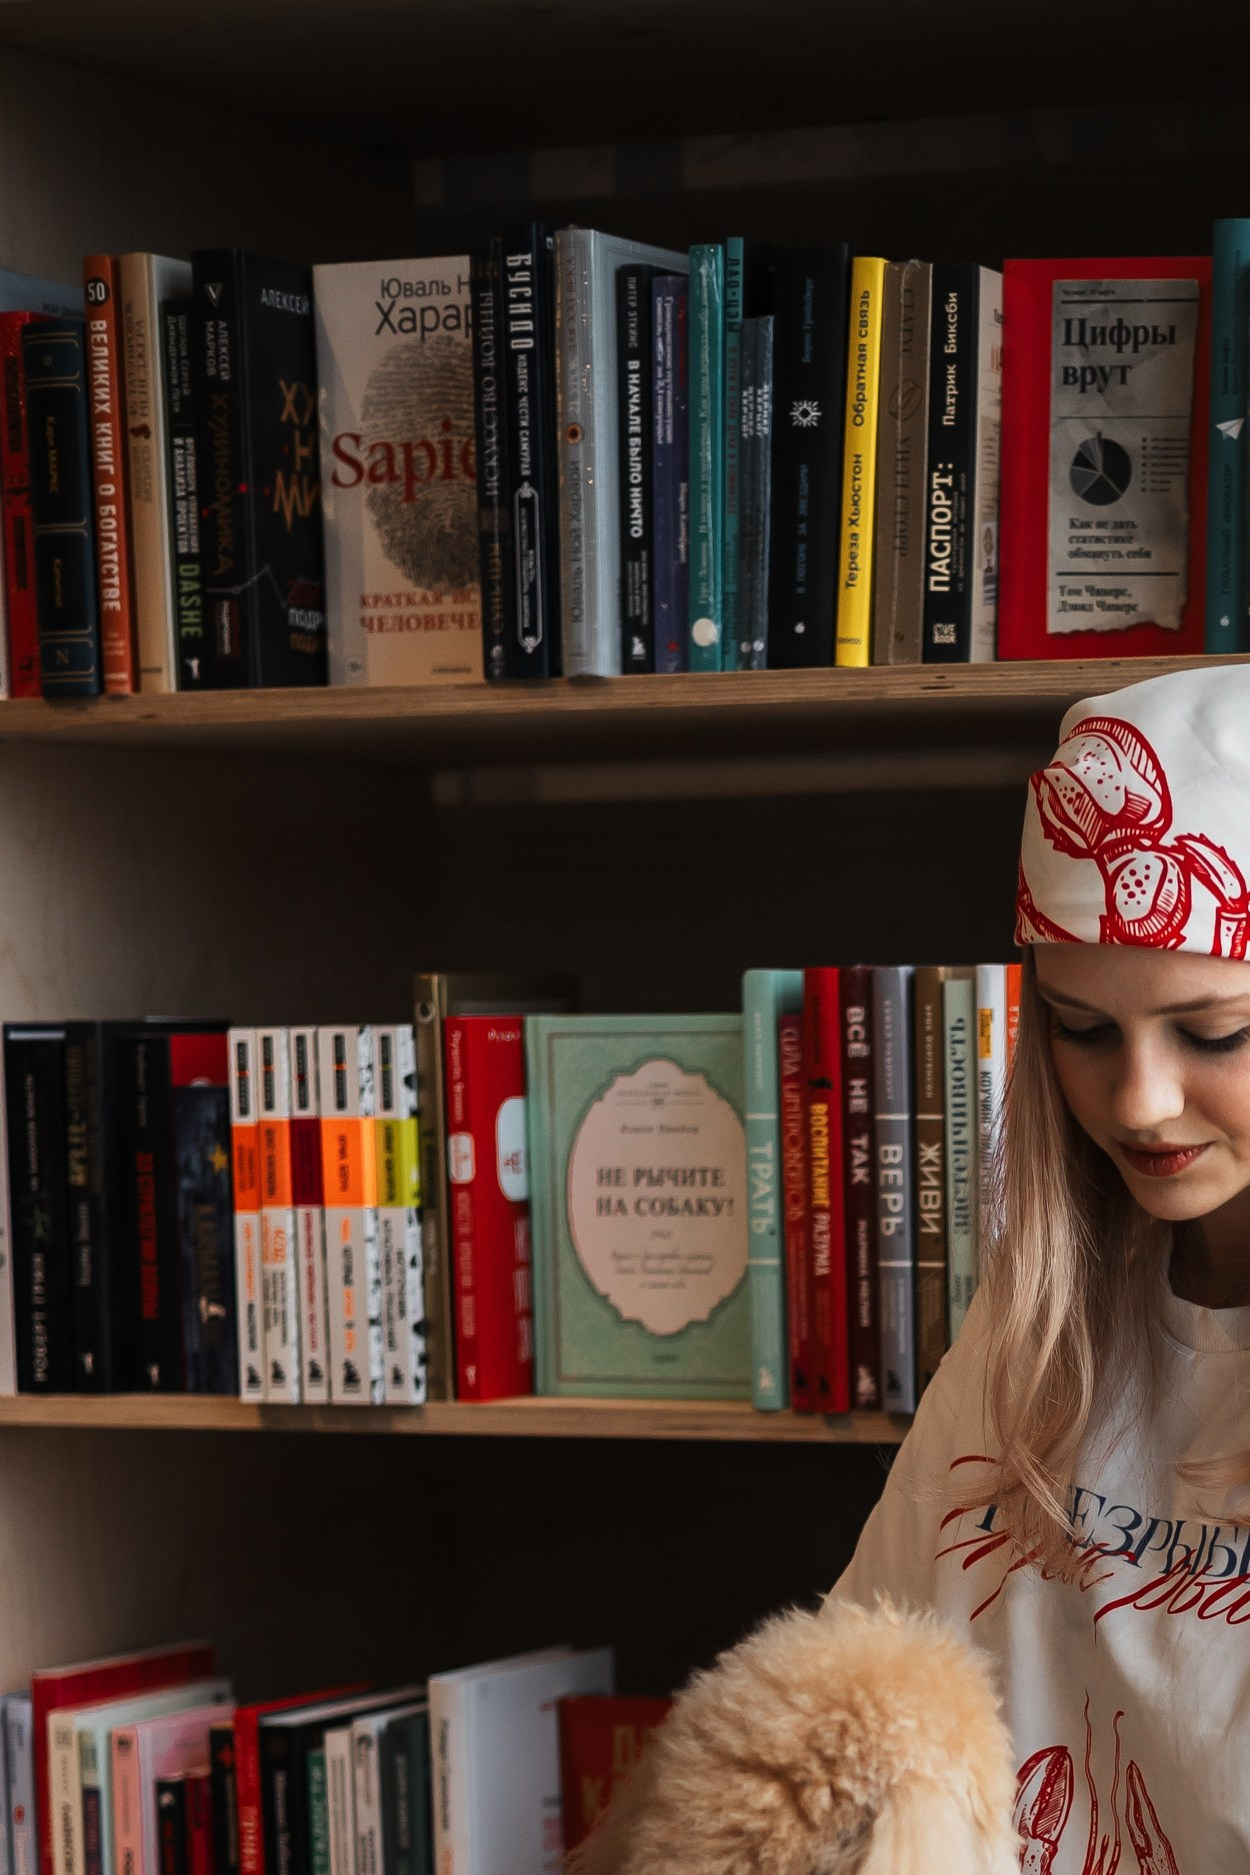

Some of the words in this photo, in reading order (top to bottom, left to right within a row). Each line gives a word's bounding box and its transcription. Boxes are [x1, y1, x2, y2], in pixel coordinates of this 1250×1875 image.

[87, 282, 105, 300] 50
[380, 277, 452, 299] Юваль
[505, 253, 534, 350] БУСИДО
[626, 276, 638, 308] ПИТЕР
[477, 291, 495, 368] ВОЙНЫ
[627, 312, 639, 348] ЭТКИНС
[856, 290, 870, 339] связь
[901, 288, 915, 360] СТАТУС
[944, 292, 958, 354] Биксби
[1063, 317, 1176, 353] Цифры
[90, 320, 110, 414] ВЕЛИКИХ
[205, 321, 216, 376] МАРКОВ
[218, 320, 231, 380] АЛЕКСЕЙ
[517, 354, 528, 394] КОДЕКС
[627, 360, 640, 370] В
[627, 373, 642, 433] НАЧАЛЕ
[852, 343, 868, 427] Обратная
[942, 364, 956, 426] Патрик
[1062, 365, 1133, 393] врут
[483, 377, 500, 496] ИСКУССТВО
[518, 397, 529, 426] ЧЕСТИ
[96, 422, 114, 475] КНИГ
[520, 429, 531, 476] САМУРАЯ
[628, 437, 642, 484] БЫЛО
[98, 484, 116, 495] О
[566, 460, 581, 524] Харари
[629, 487, 643, 538] НИЧТО
[847, 454, 863, 527] Хьюстон
[894, 488, 909, 557] СТОРР
[929, 461, 953, 593] ПАСПОРТ:
[1068, 535, 1135, 544] статистике
[1069, 518, 1090, 529] Как
[1095, 520, 1109, 529] не
[1112, 520, 1137, 529] дать
[101, 505, 121, 611] БОГАТСТВЕ
[845, 533, 861, 590] Тереза
[1068, 548, 1123, 562] обмануть
[1126, 548, 1152, 559] себя
[179, 564, 203, 638] DASHE
[359, 593, 443, 610] КРАТКАЯ
[1059, 585, 1082, 596] Том
[1097, 601, 1138, 615] Чиверс
[781, 1027, 799, 1075] СИЛА
[846, 1006, 867, 1058] ВСЁ
[849, 1079, 867, 1112] НЕ
[979, 1071, 994, 1123] КОУЧИНГ
[596, 1167, 626, 1188] НЕ
[633, 1166, 725, 1188] РЫЧИТЕ
[783, 1082, 804, 1222] ИНТРОВЕРТОВ
[808, 1103, 830, 1208] ВОСПИТАНИЕ
[850, 1135, 869, 1185] ТАК
[596, 1195, 627, 1217] НА
[634, 1195, 735, 1218] СОБАКУ!
[749, 1141, 777, 1235] ТРАТЬ
[879, 1144, 906, 1236] ВЕРЬ
[919, 1142, 943, 1234] ЖИВИ
[812, 1212, 831, 1276] РАЗУМА
